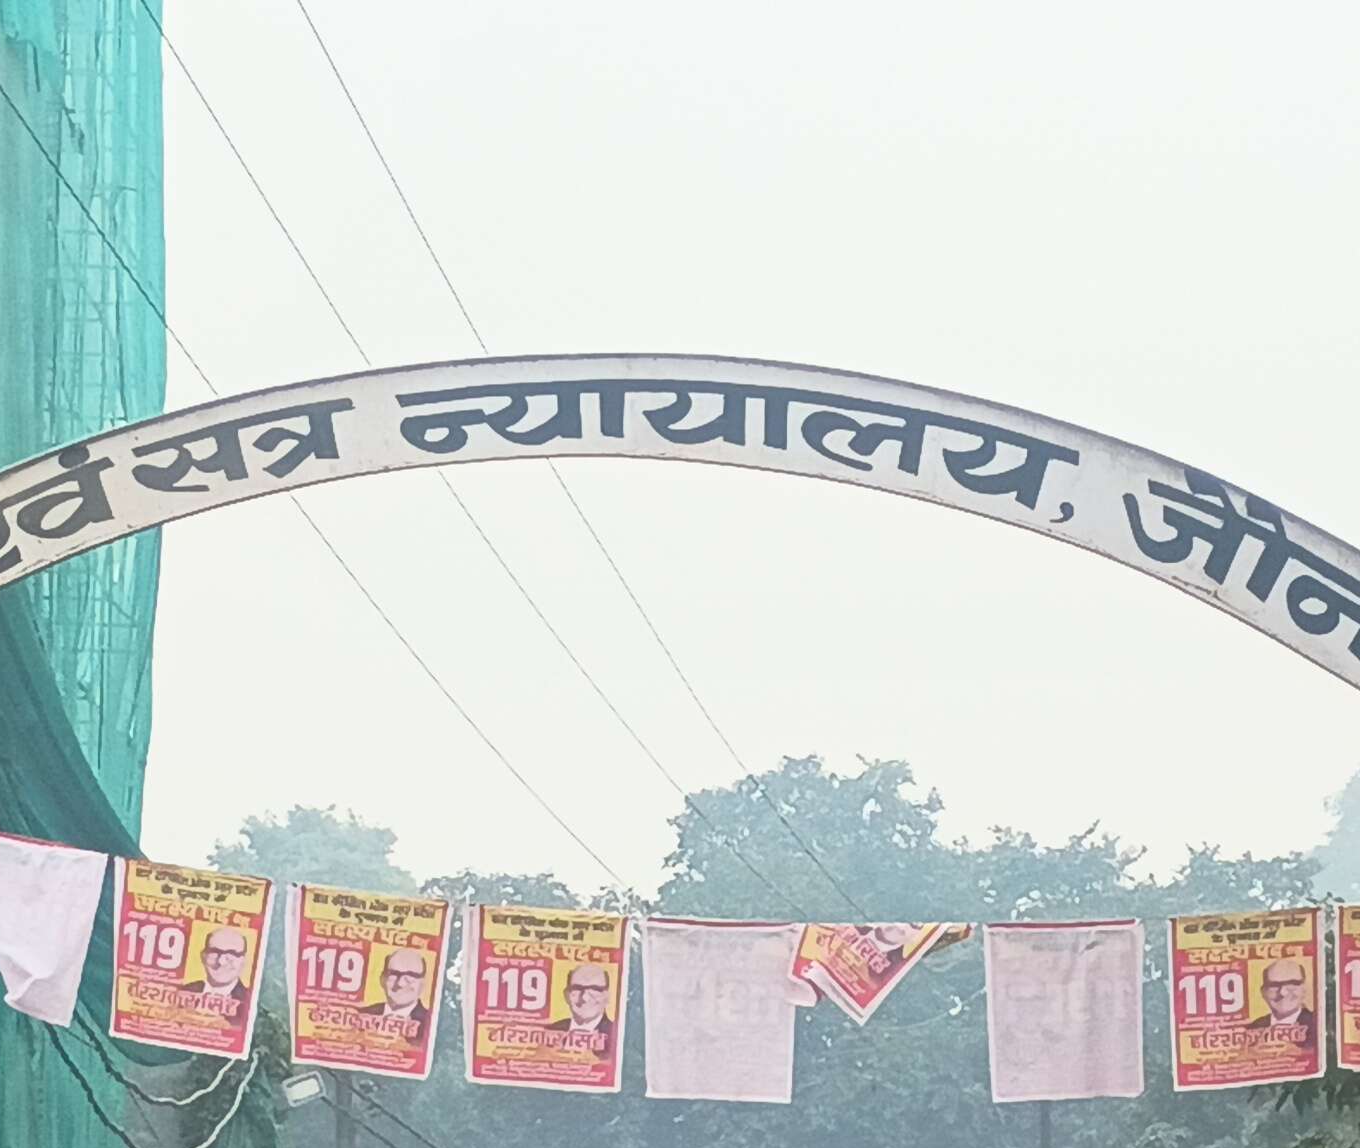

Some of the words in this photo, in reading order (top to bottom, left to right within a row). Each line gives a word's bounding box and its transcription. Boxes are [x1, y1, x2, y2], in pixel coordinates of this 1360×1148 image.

[131, 397, 354, 493] सत्र
[123, 921, 185, 969] 119
[301, 946, 365, 992] 119
[481, 967, 548, 1011] 119
[1178, 972, 1245, 1015] 119
